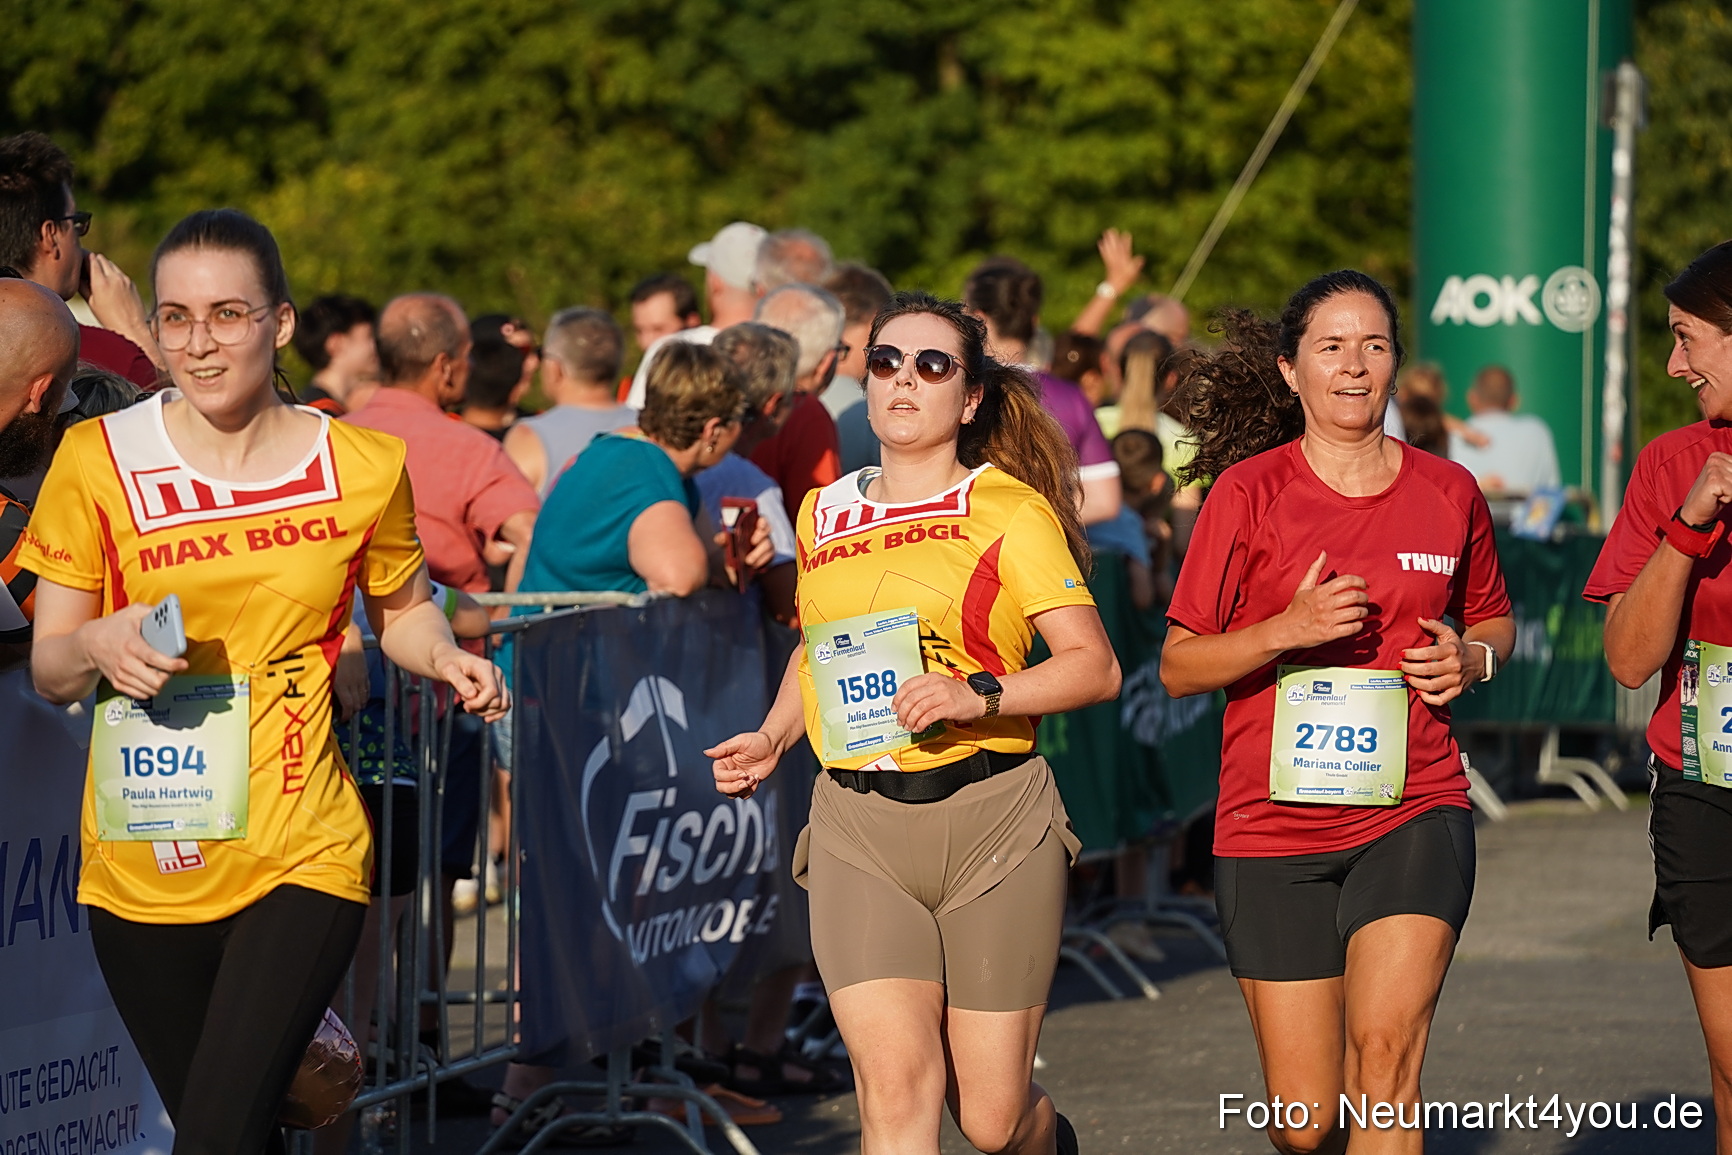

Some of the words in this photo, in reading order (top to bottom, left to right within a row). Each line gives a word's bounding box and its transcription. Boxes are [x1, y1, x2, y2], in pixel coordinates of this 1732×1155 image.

[1430, 273, 1543, 328] AOK
[139, 533, 233, 573] MAX
[245, 517, 348, 552] BÖGL
[806, 539, 873, 573] MAX
[884, 523, 970, 550] BÖGL
[832, 643, 865, 657] Firmenlauf
[1685, 650, 1698, 658] AOK
[837, 669, 897, 705] 1588
[1306, 693, 1347, 702] Firmenlauf
[847, 710, 867, 723] Julia
[1295, 722, 1378, 753] 2783
[120, 745, 207, 778] 1694
[1293, 757, 1341, 770] Mariana
[1344, 760, 1382, 772] Collier
[122, 788, 156, 800] Paula
[159, 786, 213, 801] Hartwig
[0, 834, 91, 948] AN
[37, 1045, 121, 1105] GEDACHT,
[54, 1103, 146, 1155] GEMACHT.
